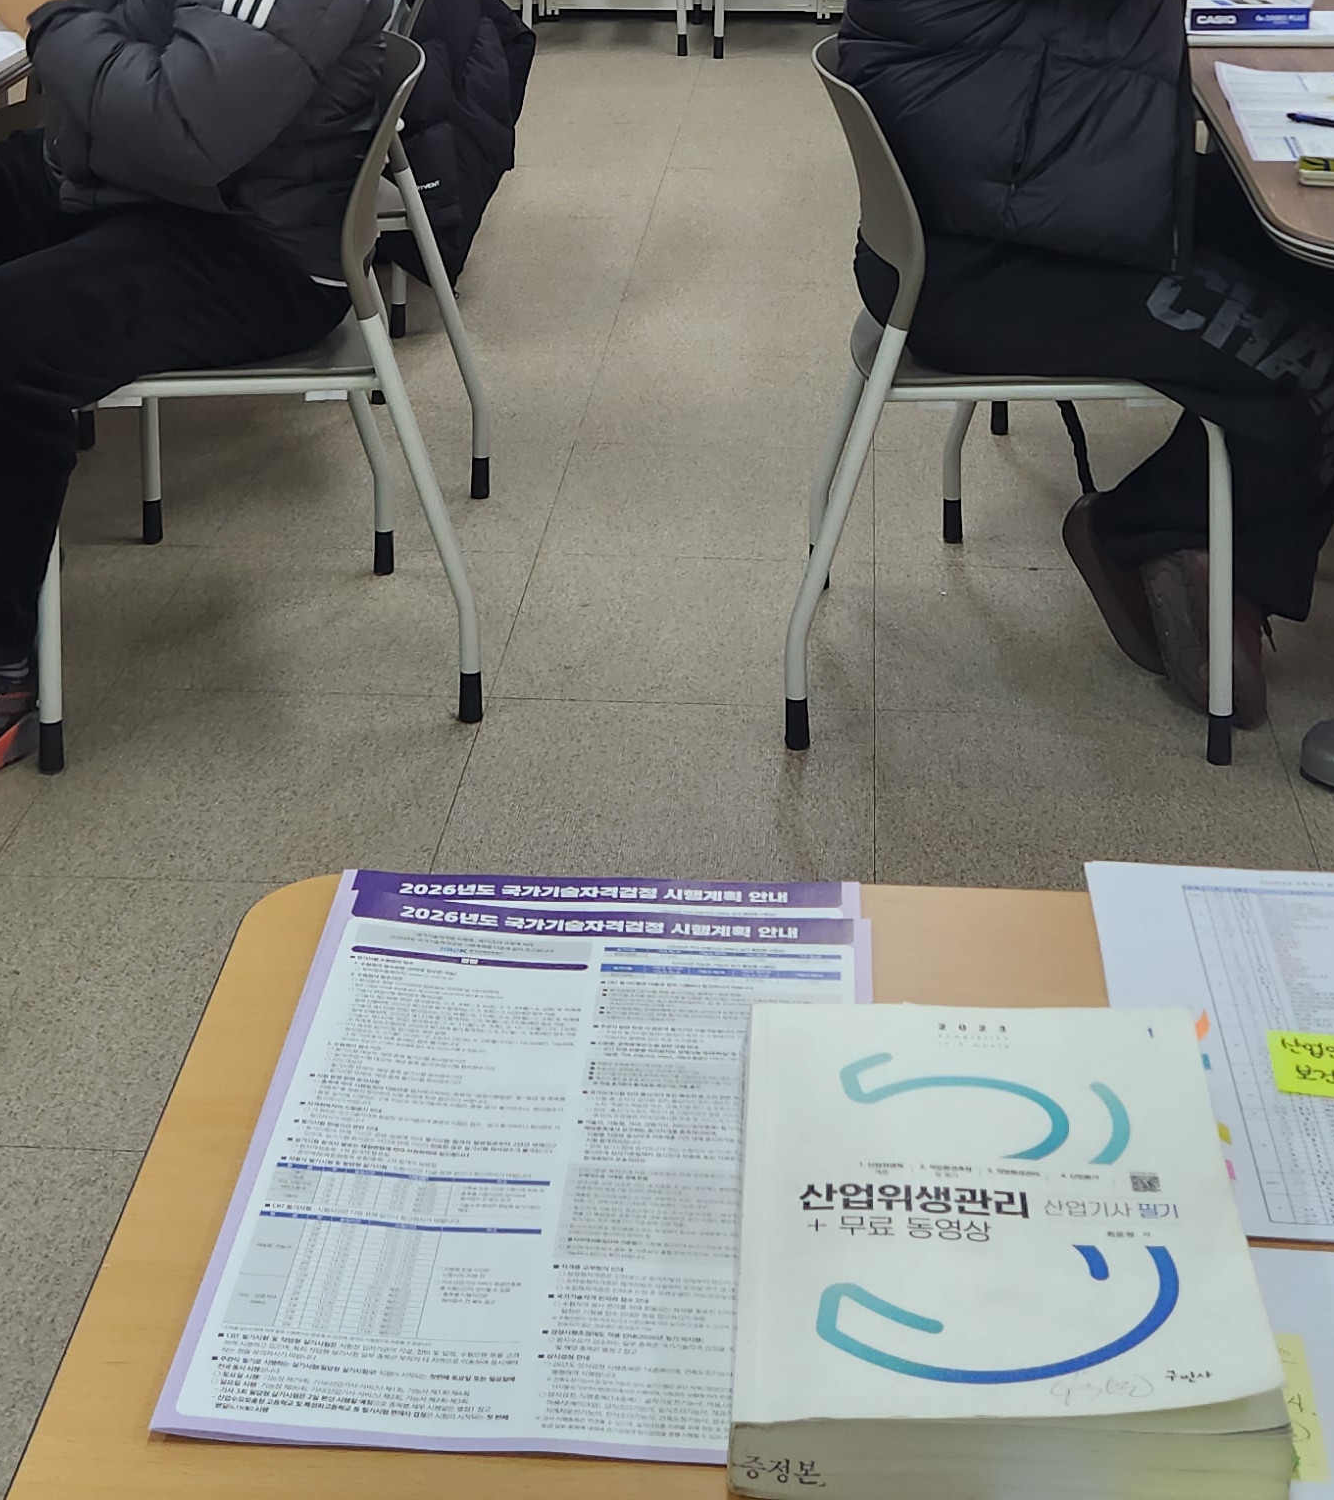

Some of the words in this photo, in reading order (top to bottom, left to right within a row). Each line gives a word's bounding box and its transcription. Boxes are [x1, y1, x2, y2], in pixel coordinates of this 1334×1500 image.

[1196, 15, 1237, 25] CASIO
[399, 881, 497, 897] 2026년도
[501, 883, 662, 902] 국가기술자격검정
[666, 887, 744, 903] 시행계획
[748, 888, 789, 904] 안내
[400, 905, 500, 927] 2026년도
[504, 914, 666, 936] 국가기술자격검정
[669, 922, 753, 939] 시행계획
[758, 925, 799, 940] 안내
[799, 1182, 1031, 1219] 산업위생관리
[1043, 1198, 1132, 1218] 산업기사
[1138, 1201, 1180, 1219] 필기
[839, 1216, 895, 1238] 무료
[906, 1217, 993, 1243] 동영상
[738, 1456, 822, 1487] 증정본
